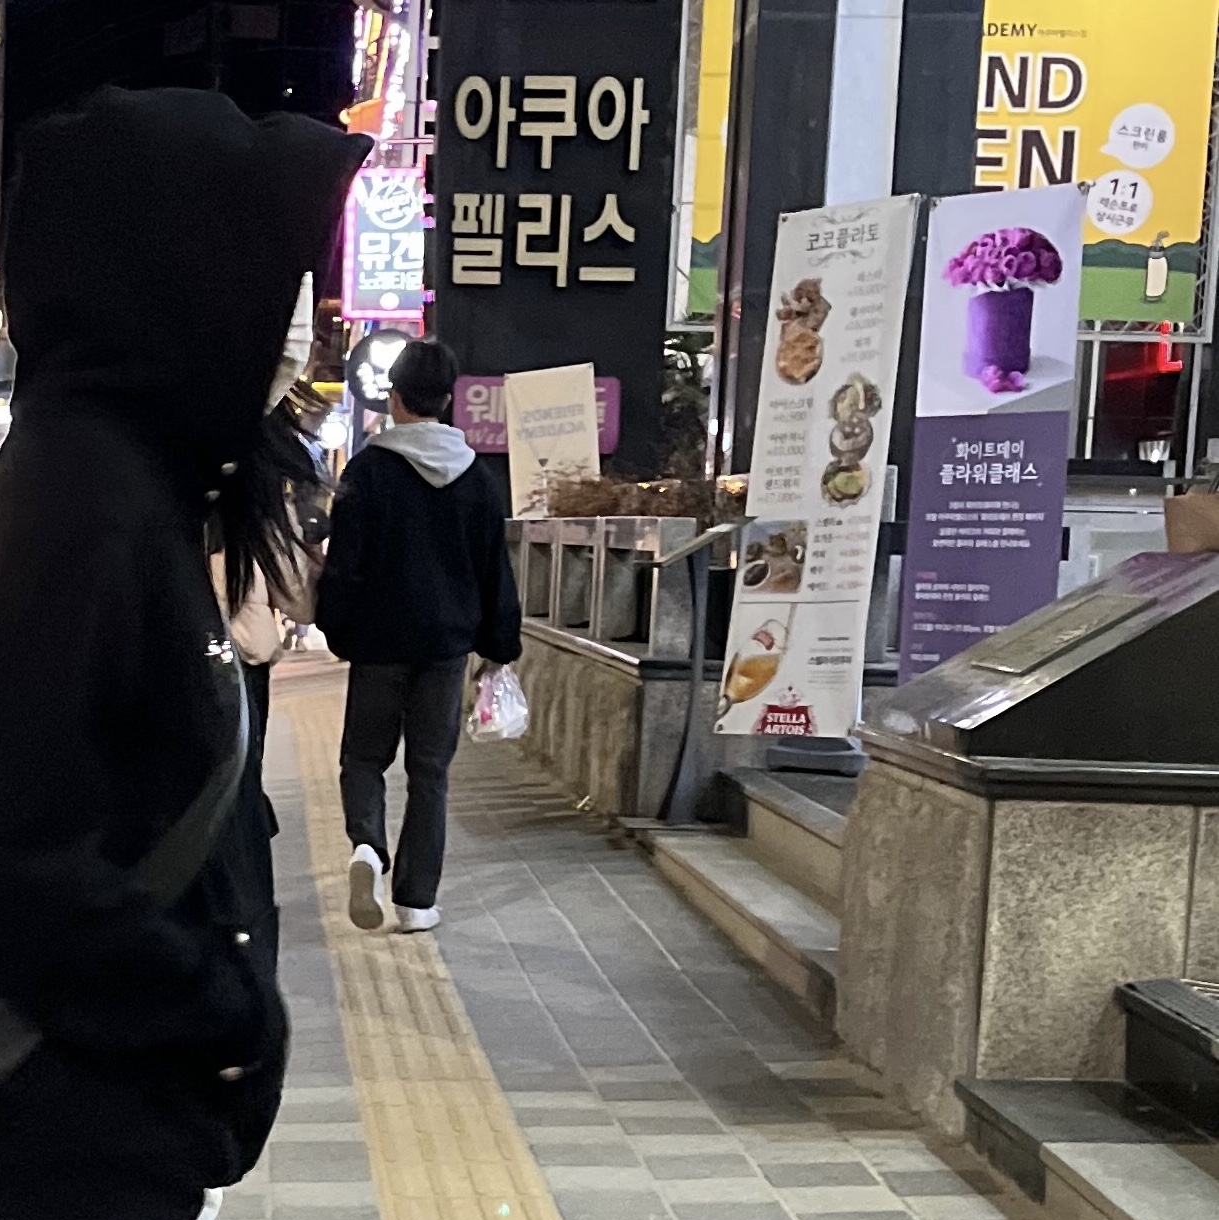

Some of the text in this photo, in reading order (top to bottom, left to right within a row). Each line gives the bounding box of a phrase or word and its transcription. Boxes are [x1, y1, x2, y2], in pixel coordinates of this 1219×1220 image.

[983, 22, 1038, 37] DEMY
[454, 75, 650, 171] 아쿠아
[1110, 178, 1139, 199] 1:1
[451, 193, 636, 288] 펠리스
[954, 440, 1025, 460] 화이트데이
[939, 462, 1039, 485] 플라워클래스
[766, 712, 806, 723] STELLA
[763, 724, 806, 735] ARTOIS
